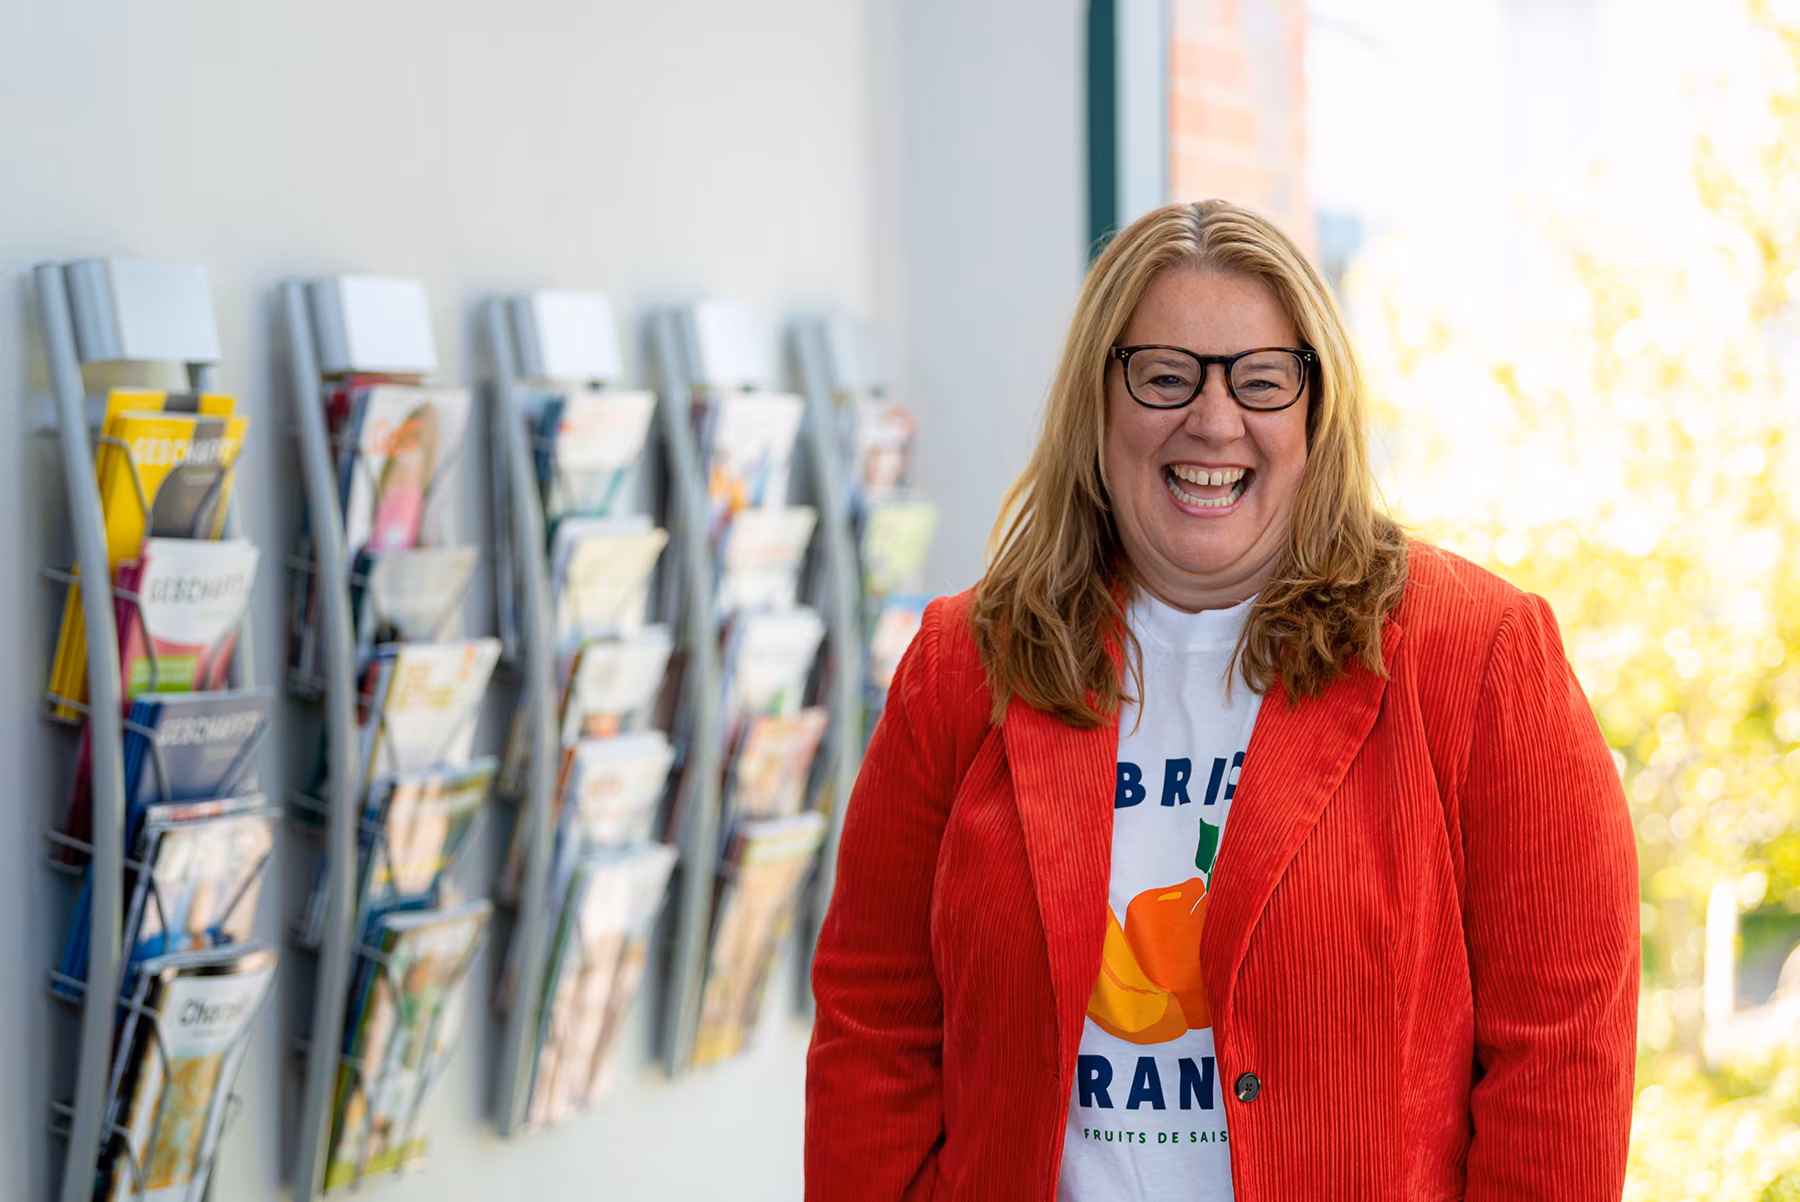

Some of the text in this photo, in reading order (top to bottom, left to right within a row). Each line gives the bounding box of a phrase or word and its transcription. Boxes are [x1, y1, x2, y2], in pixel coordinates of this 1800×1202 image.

[1077, 1054, 1215, 1110] RAN
[1084, 1128, 1228, 1144] FRUITS DE SAIS
